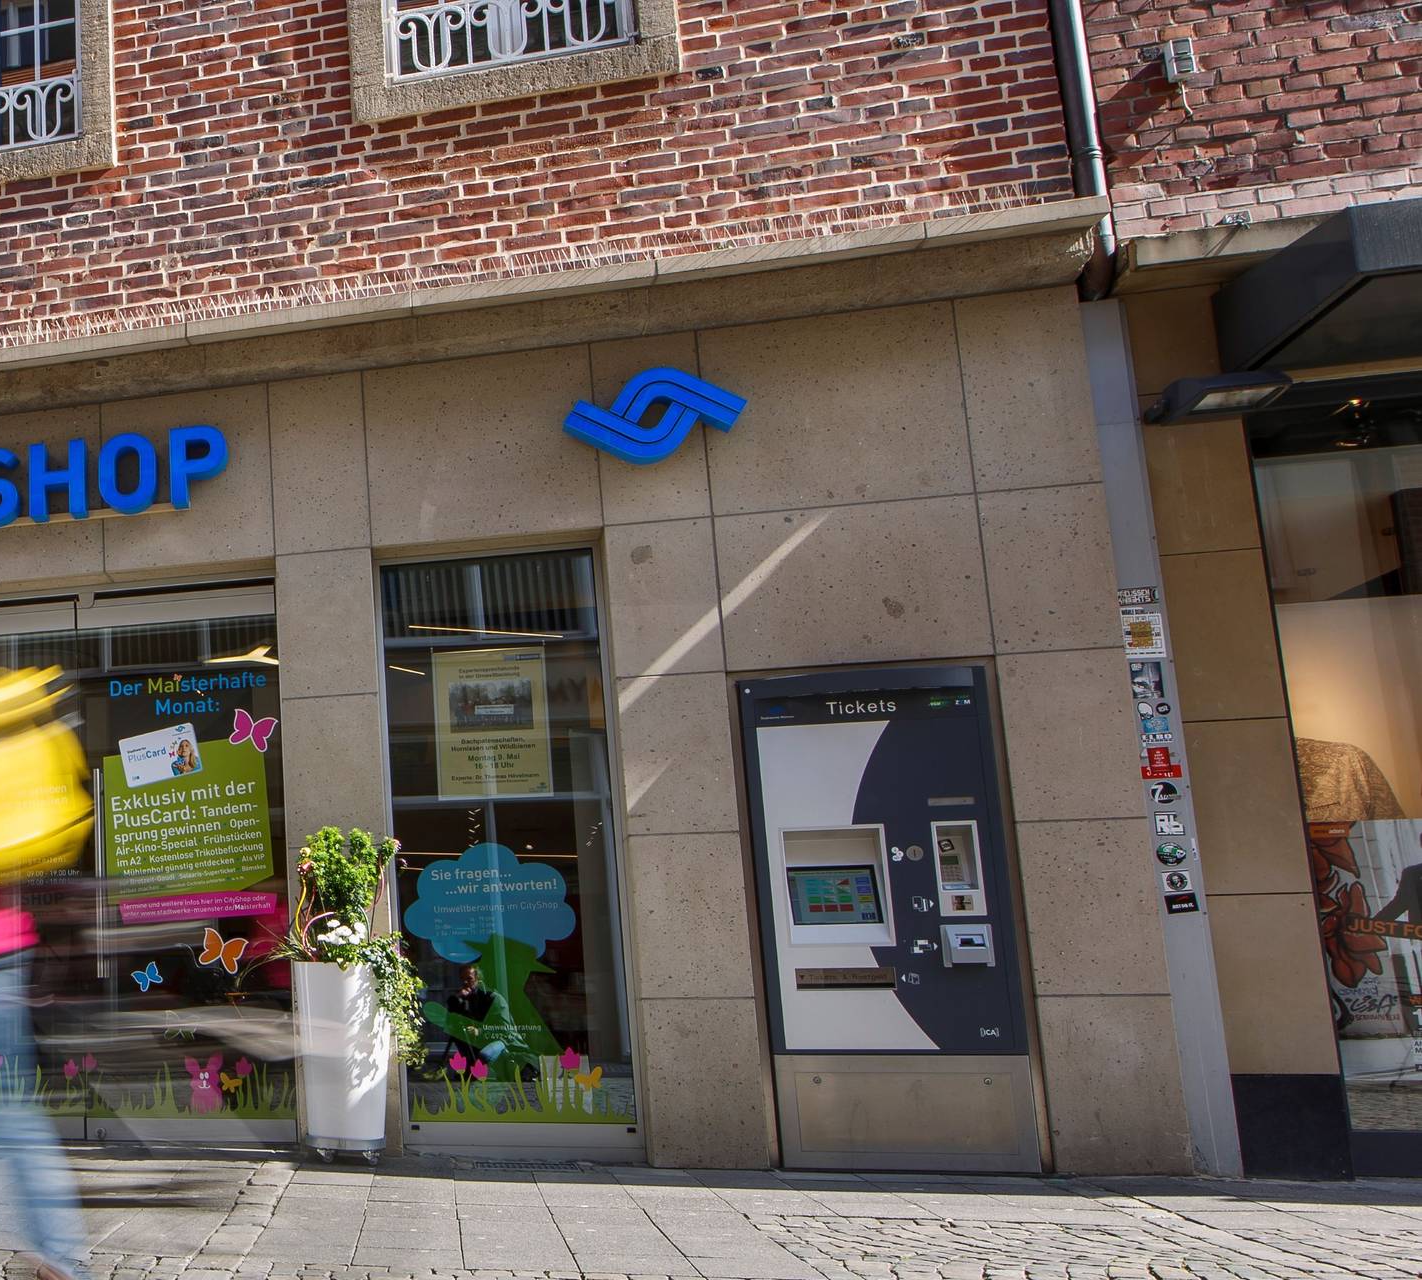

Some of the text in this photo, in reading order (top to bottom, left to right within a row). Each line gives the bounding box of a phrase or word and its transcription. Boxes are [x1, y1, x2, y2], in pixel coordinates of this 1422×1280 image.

[110, 672, 267, 697] Der Maisterhafte
[155, 698, 220, 716] Monat:
[826, 700, 897, 715] Tickets
[128, 747, 167, 763] PlusCard
[500, 761, 515, 769] Uhr
[111, 780, 256, 812] Exklusiv mit der
[113, 803, 258, 830] PlusCard: Tandem-
[114, 818, 260, 845] sprung gewinnen Open-
[116, 828, 262, 856] Air-Kino-Special Frühstücken
[117, 842, 264, 868] im A2 Kostenlose Trikotbeflockung
[124, 864, 164, 877] Mühlenhof
[165, 861, 194, 874] günstig
[195, 857, 235, 869] entdecken
[431, 868, 512, 882] Sie fragen...
[445, 878, 557, 895] ...wir antworten!
[124, 902, 148, 910] Termine
[161, 899, 183, 907] weitere
[184, 898, 200, 906] Infos
[201, 897, 214, 905] hier
[224, 895, 252, 905] CityShop
[252, 894, 267, 902] oder
[433, 903, 505, 914] Umweltberatung
[520, 901, 559, 911] CityShop
[1348, 918, 1398, 935] JUST
